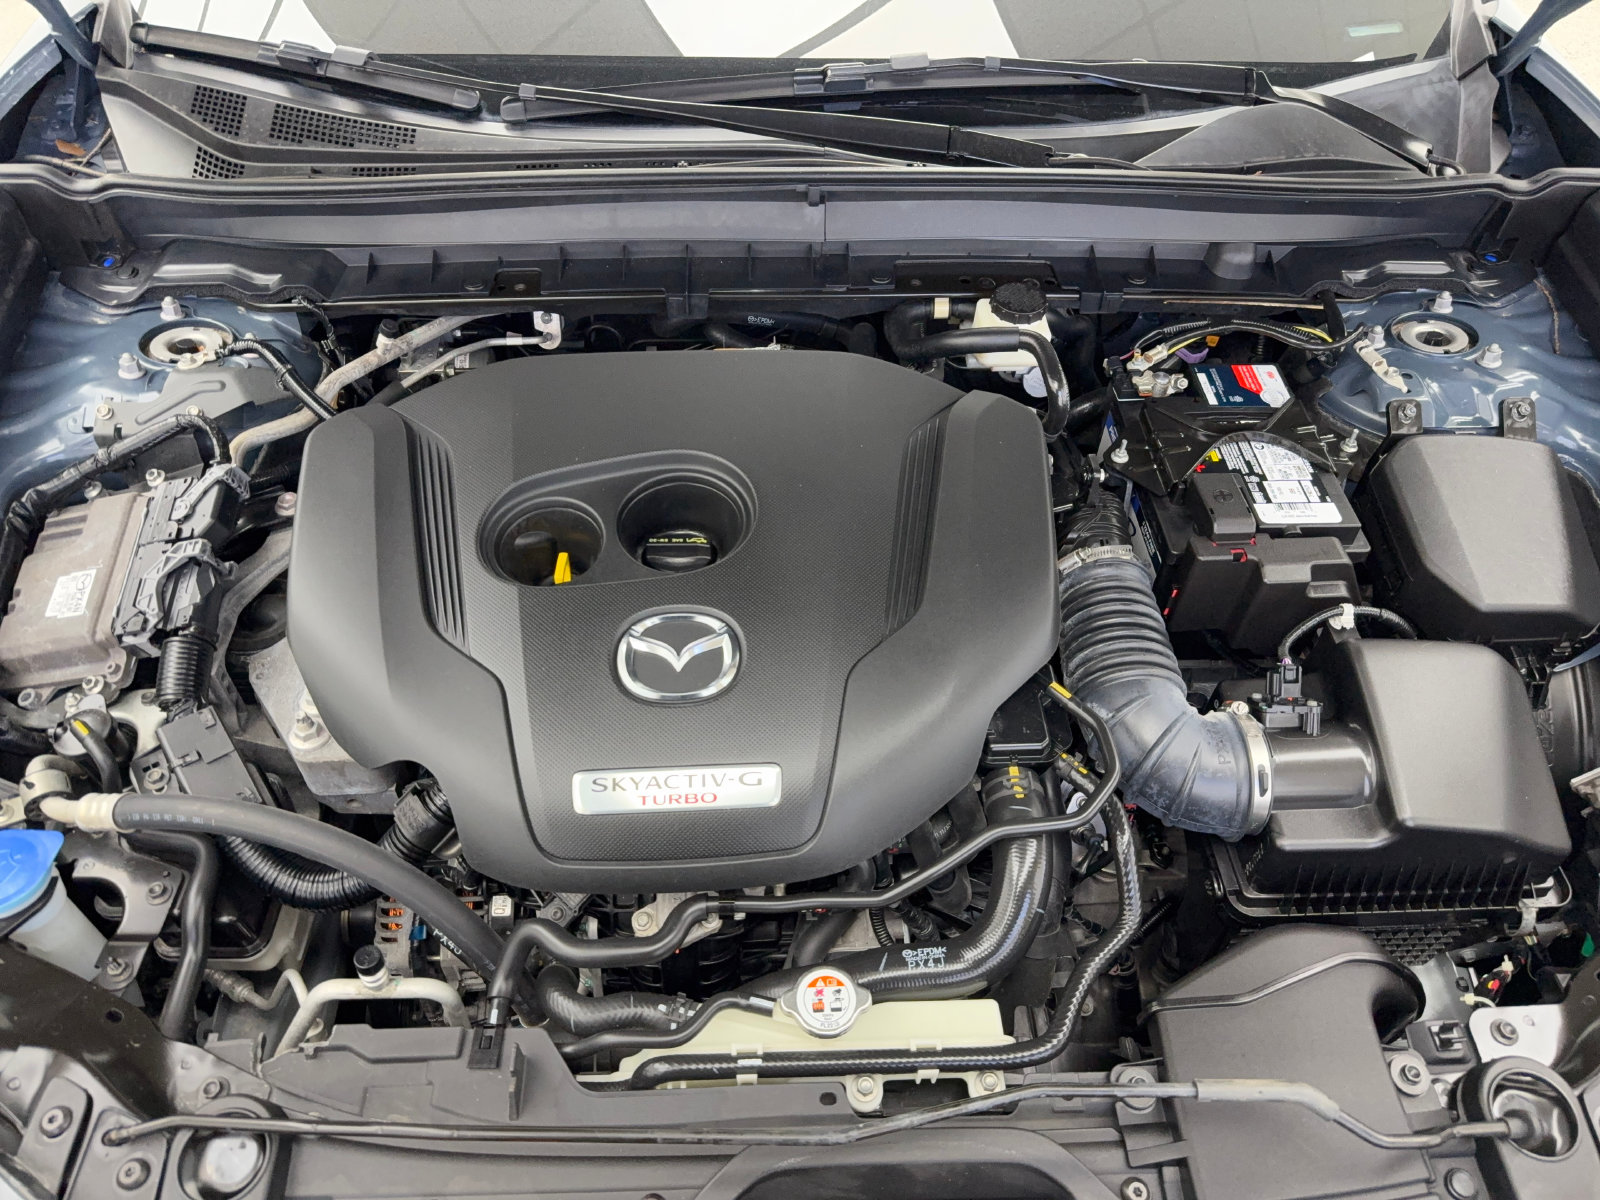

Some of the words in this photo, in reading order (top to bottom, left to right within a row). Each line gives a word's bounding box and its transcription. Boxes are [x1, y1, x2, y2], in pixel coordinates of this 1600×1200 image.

[591, 771, 763, 794] SKYACTIV-G
[637, 792, 718, 806] TURBO
[908, 957, 945, 971] PX4J
